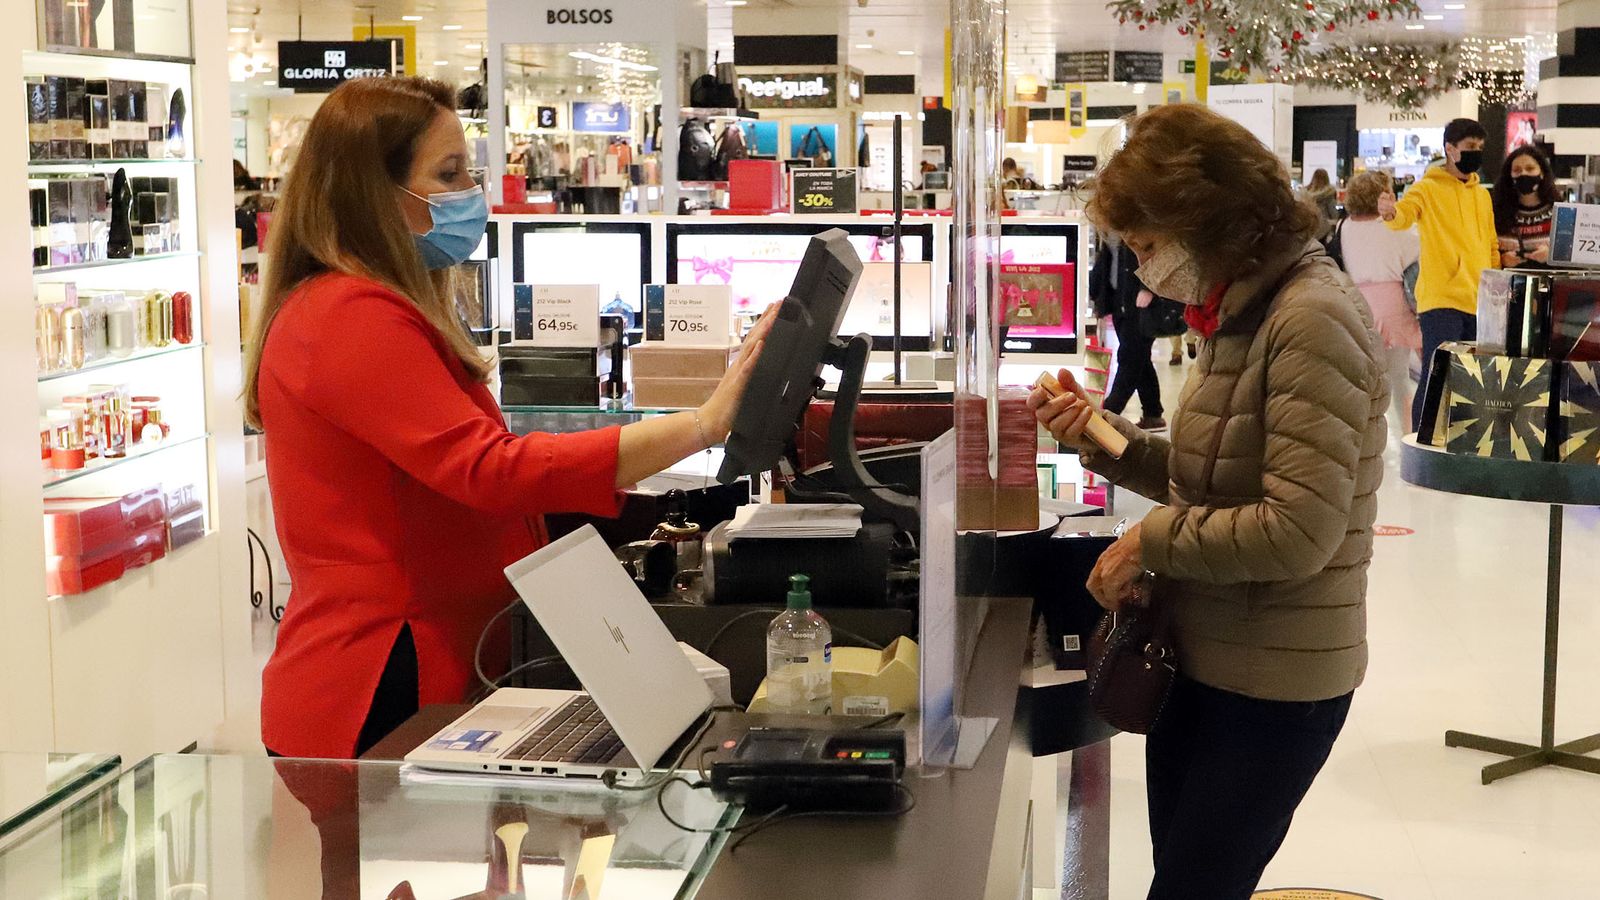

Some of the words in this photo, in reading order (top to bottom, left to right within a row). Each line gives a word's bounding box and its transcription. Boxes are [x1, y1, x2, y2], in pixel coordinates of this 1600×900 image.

[546, 8, 613, 24] BOLSOS
[283, 67, 339, 79] GLORIA
[343, 68, 386, 79] ORTIZ
[1389, 112, 1428, 121] FESTINA
[798, 193, 833, 207] -30%
[538, 318, 579, 331] 64,95€
[669, 319, 709, 332] 70,95€
